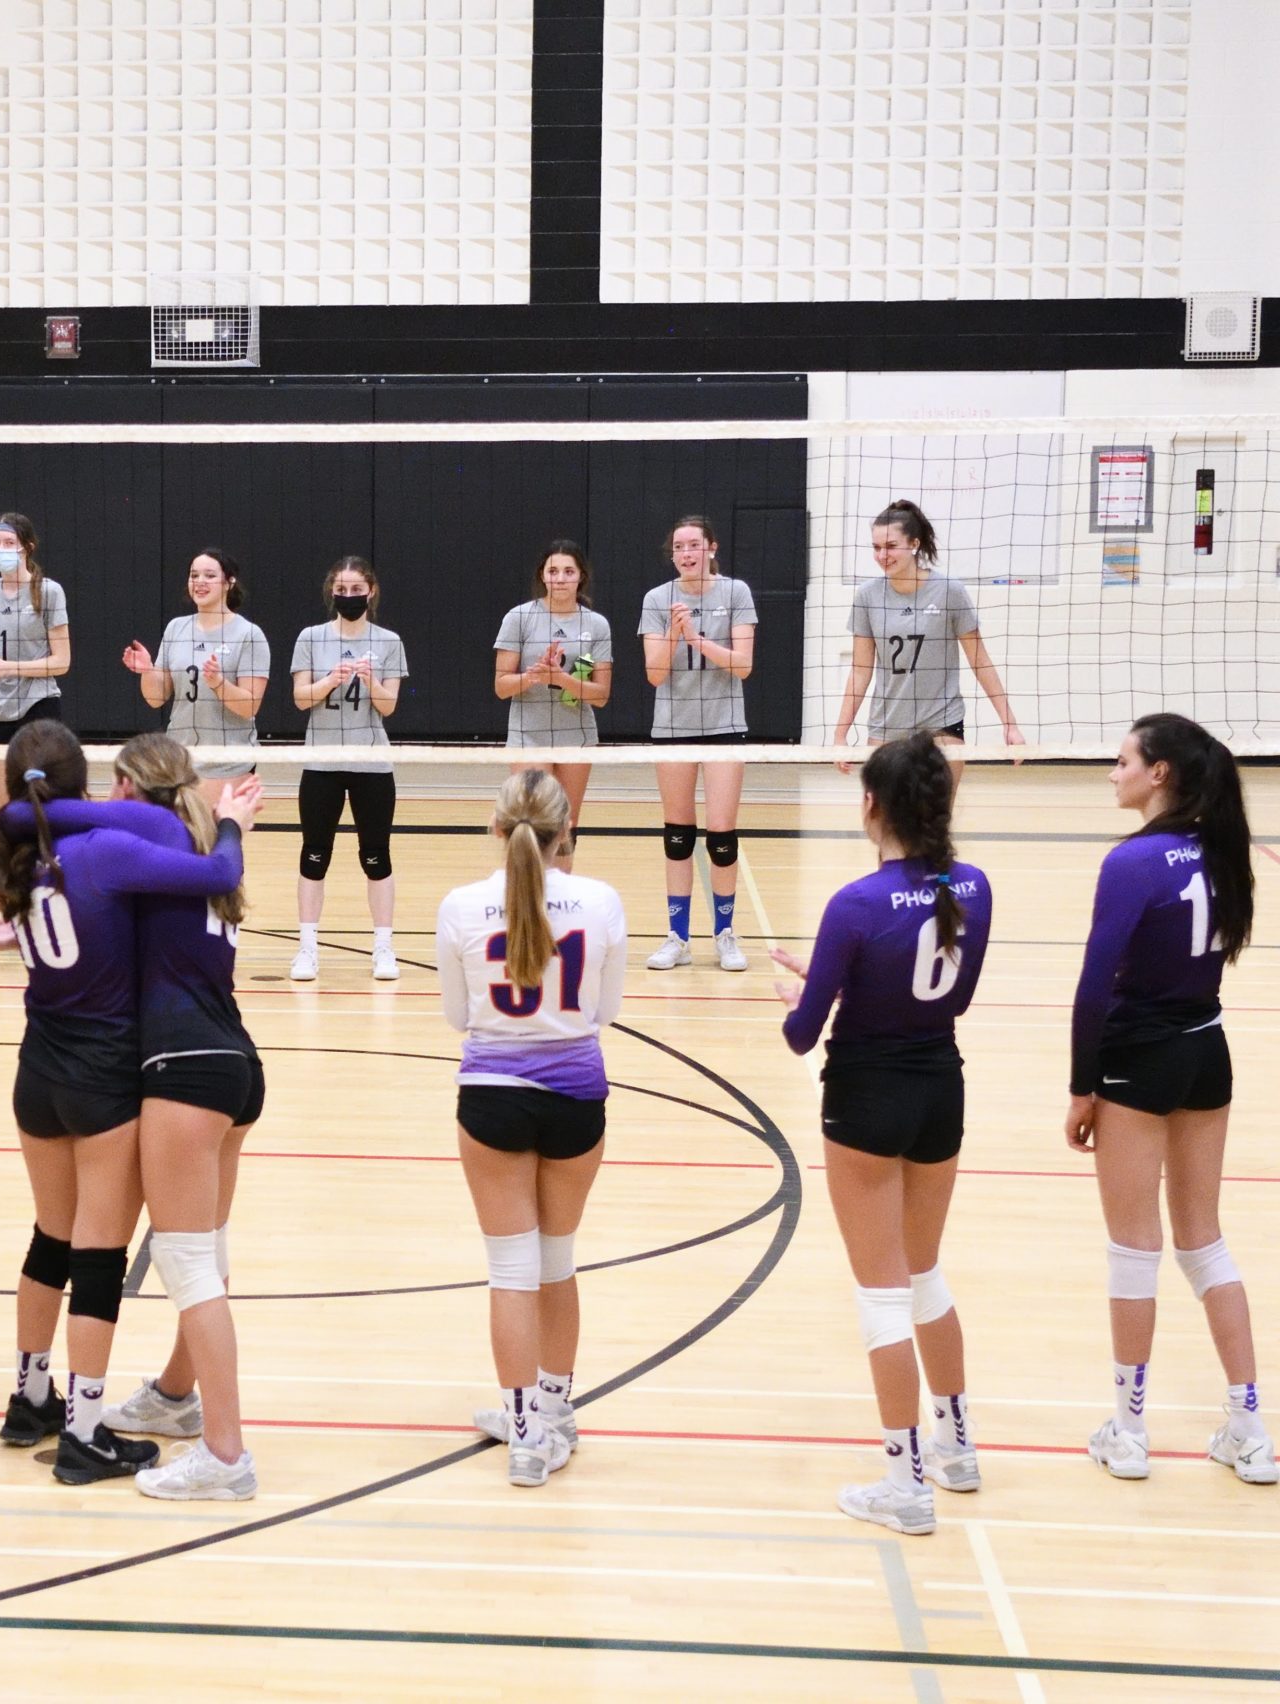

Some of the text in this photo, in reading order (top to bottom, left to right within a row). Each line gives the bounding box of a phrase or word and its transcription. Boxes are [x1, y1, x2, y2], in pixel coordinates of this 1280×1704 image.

[185, 665, 199, 703] 3
[889, 634, 926, 674] 27
[485, 928, 586, 1018] 31
[911, 915, 967, 1001] 6
